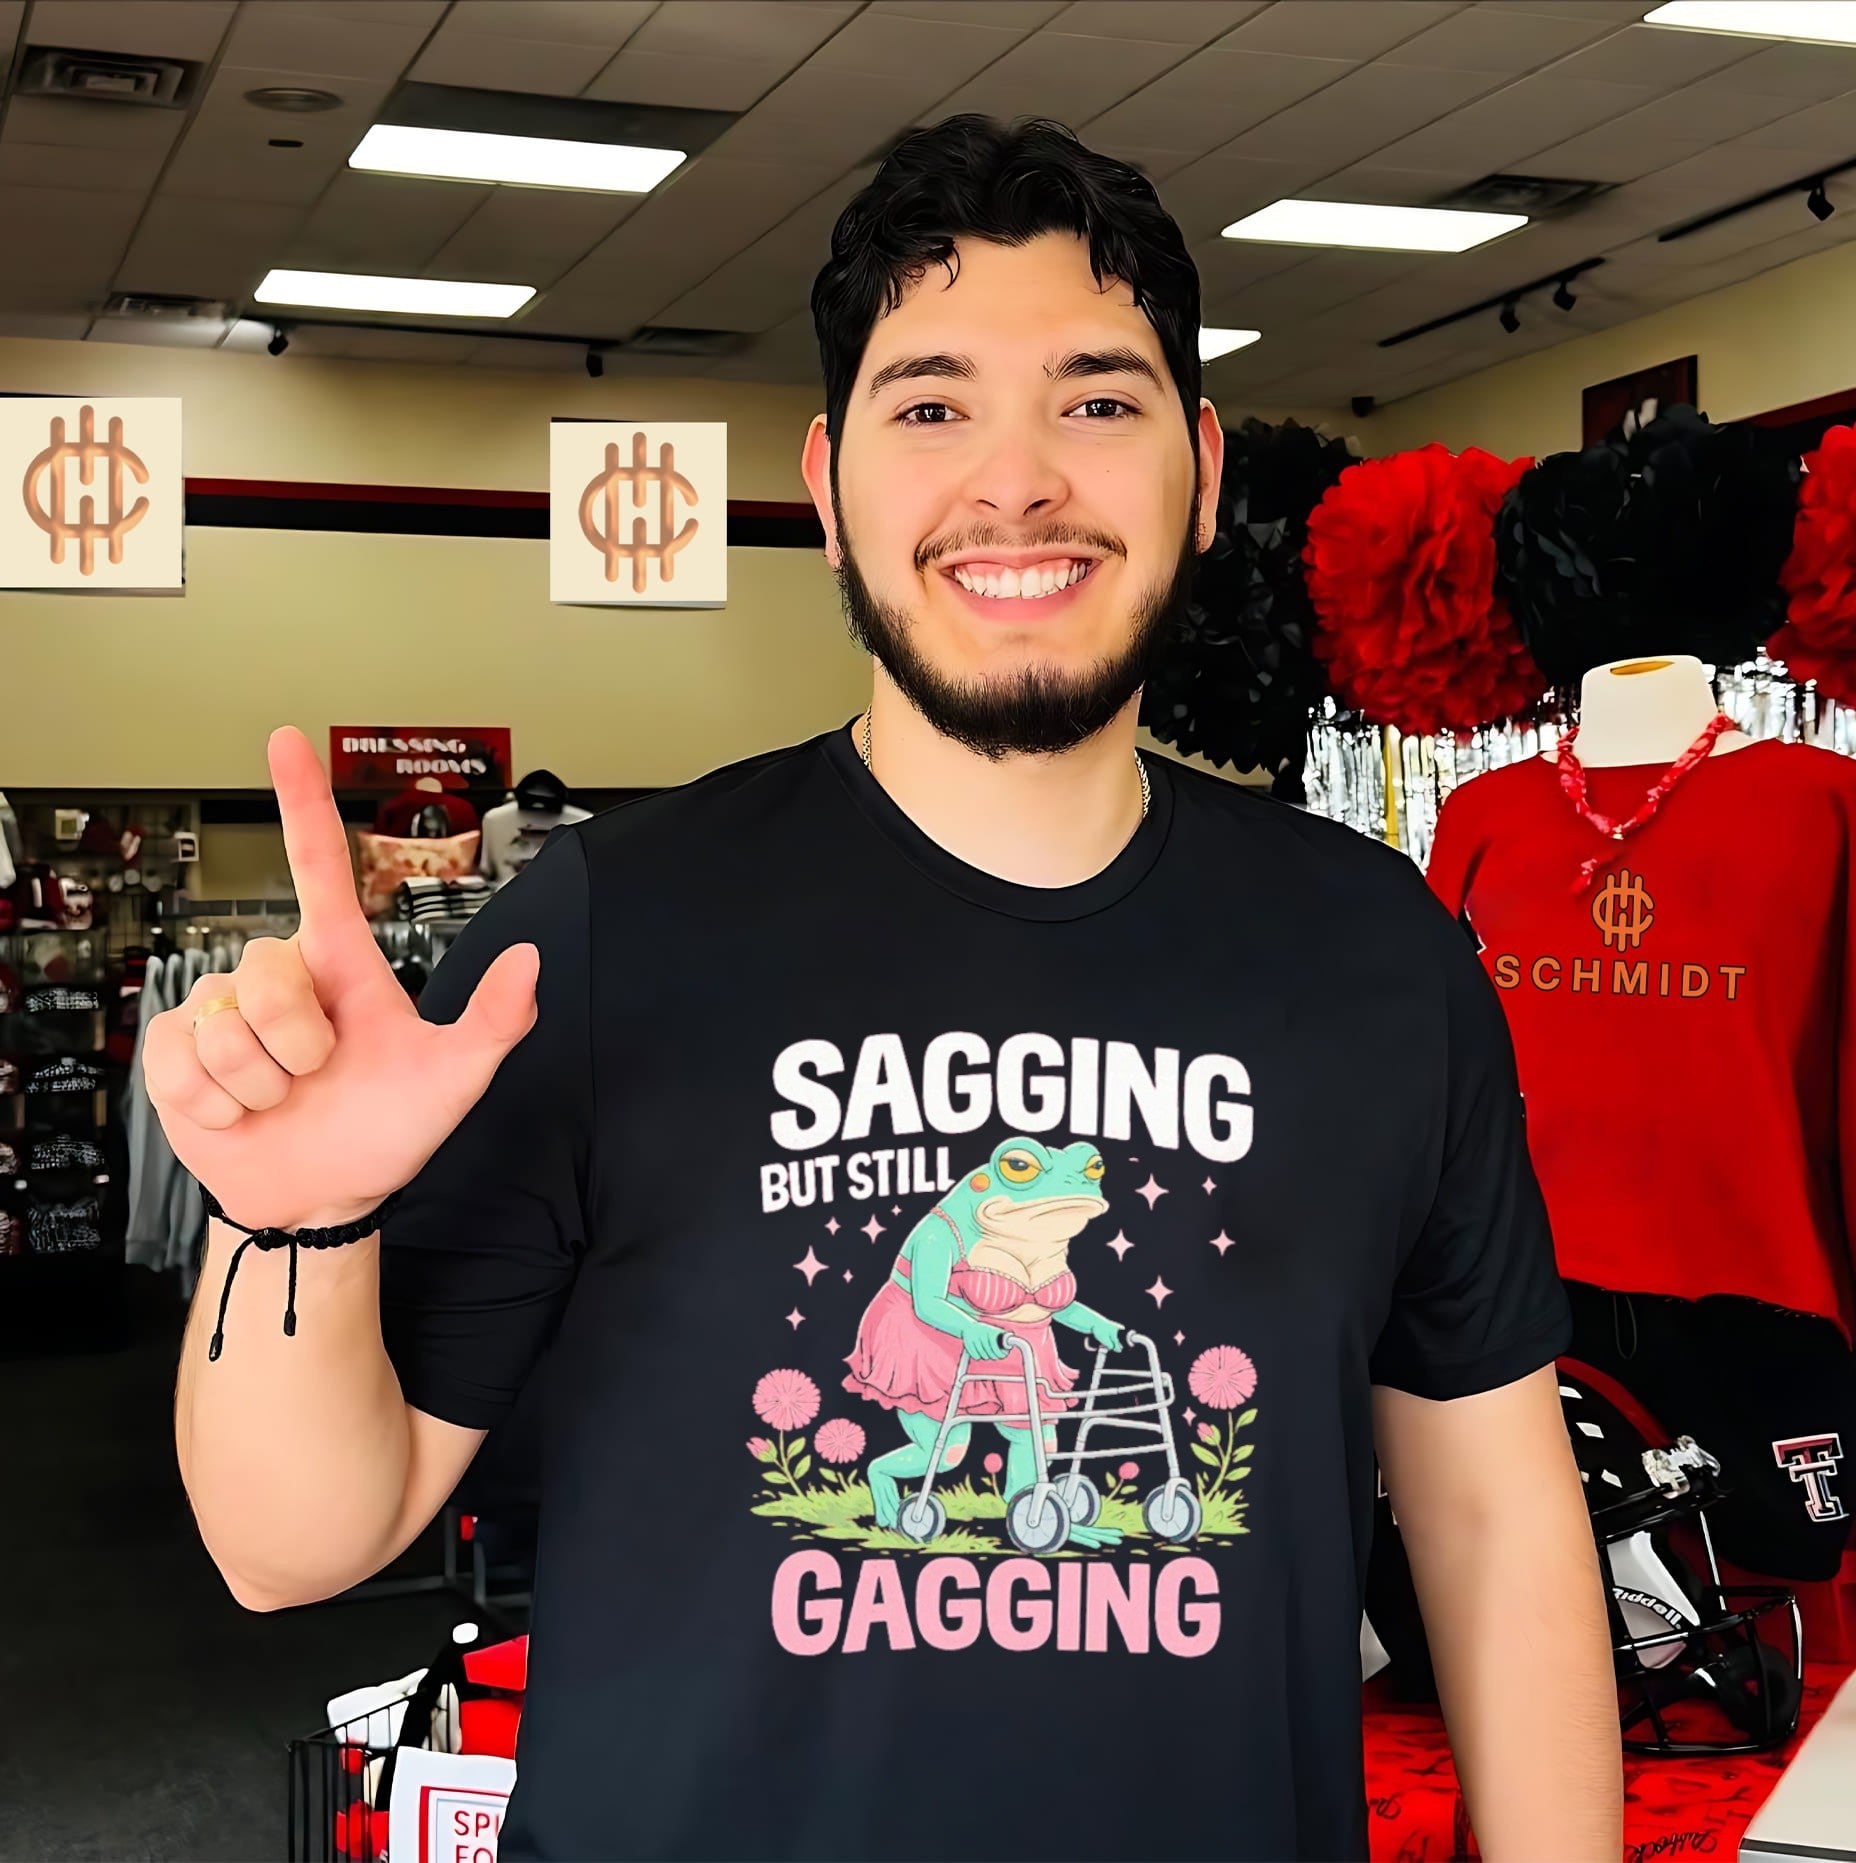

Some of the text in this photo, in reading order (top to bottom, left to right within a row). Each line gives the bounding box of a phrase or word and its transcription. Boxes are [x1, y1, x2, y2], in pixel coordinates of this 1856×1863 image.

[341, 737, 467, 754] DRESSING
[396, 758, 487, 775] ROOMS
[1494, 953, 1747, 1000] SCHMIDT
[769, 1030, 1255, 1164] SAGGING
[760, 1145, 956, 1214] BUT STILL
[770, 1548, 1222, 1658] GAGGING
